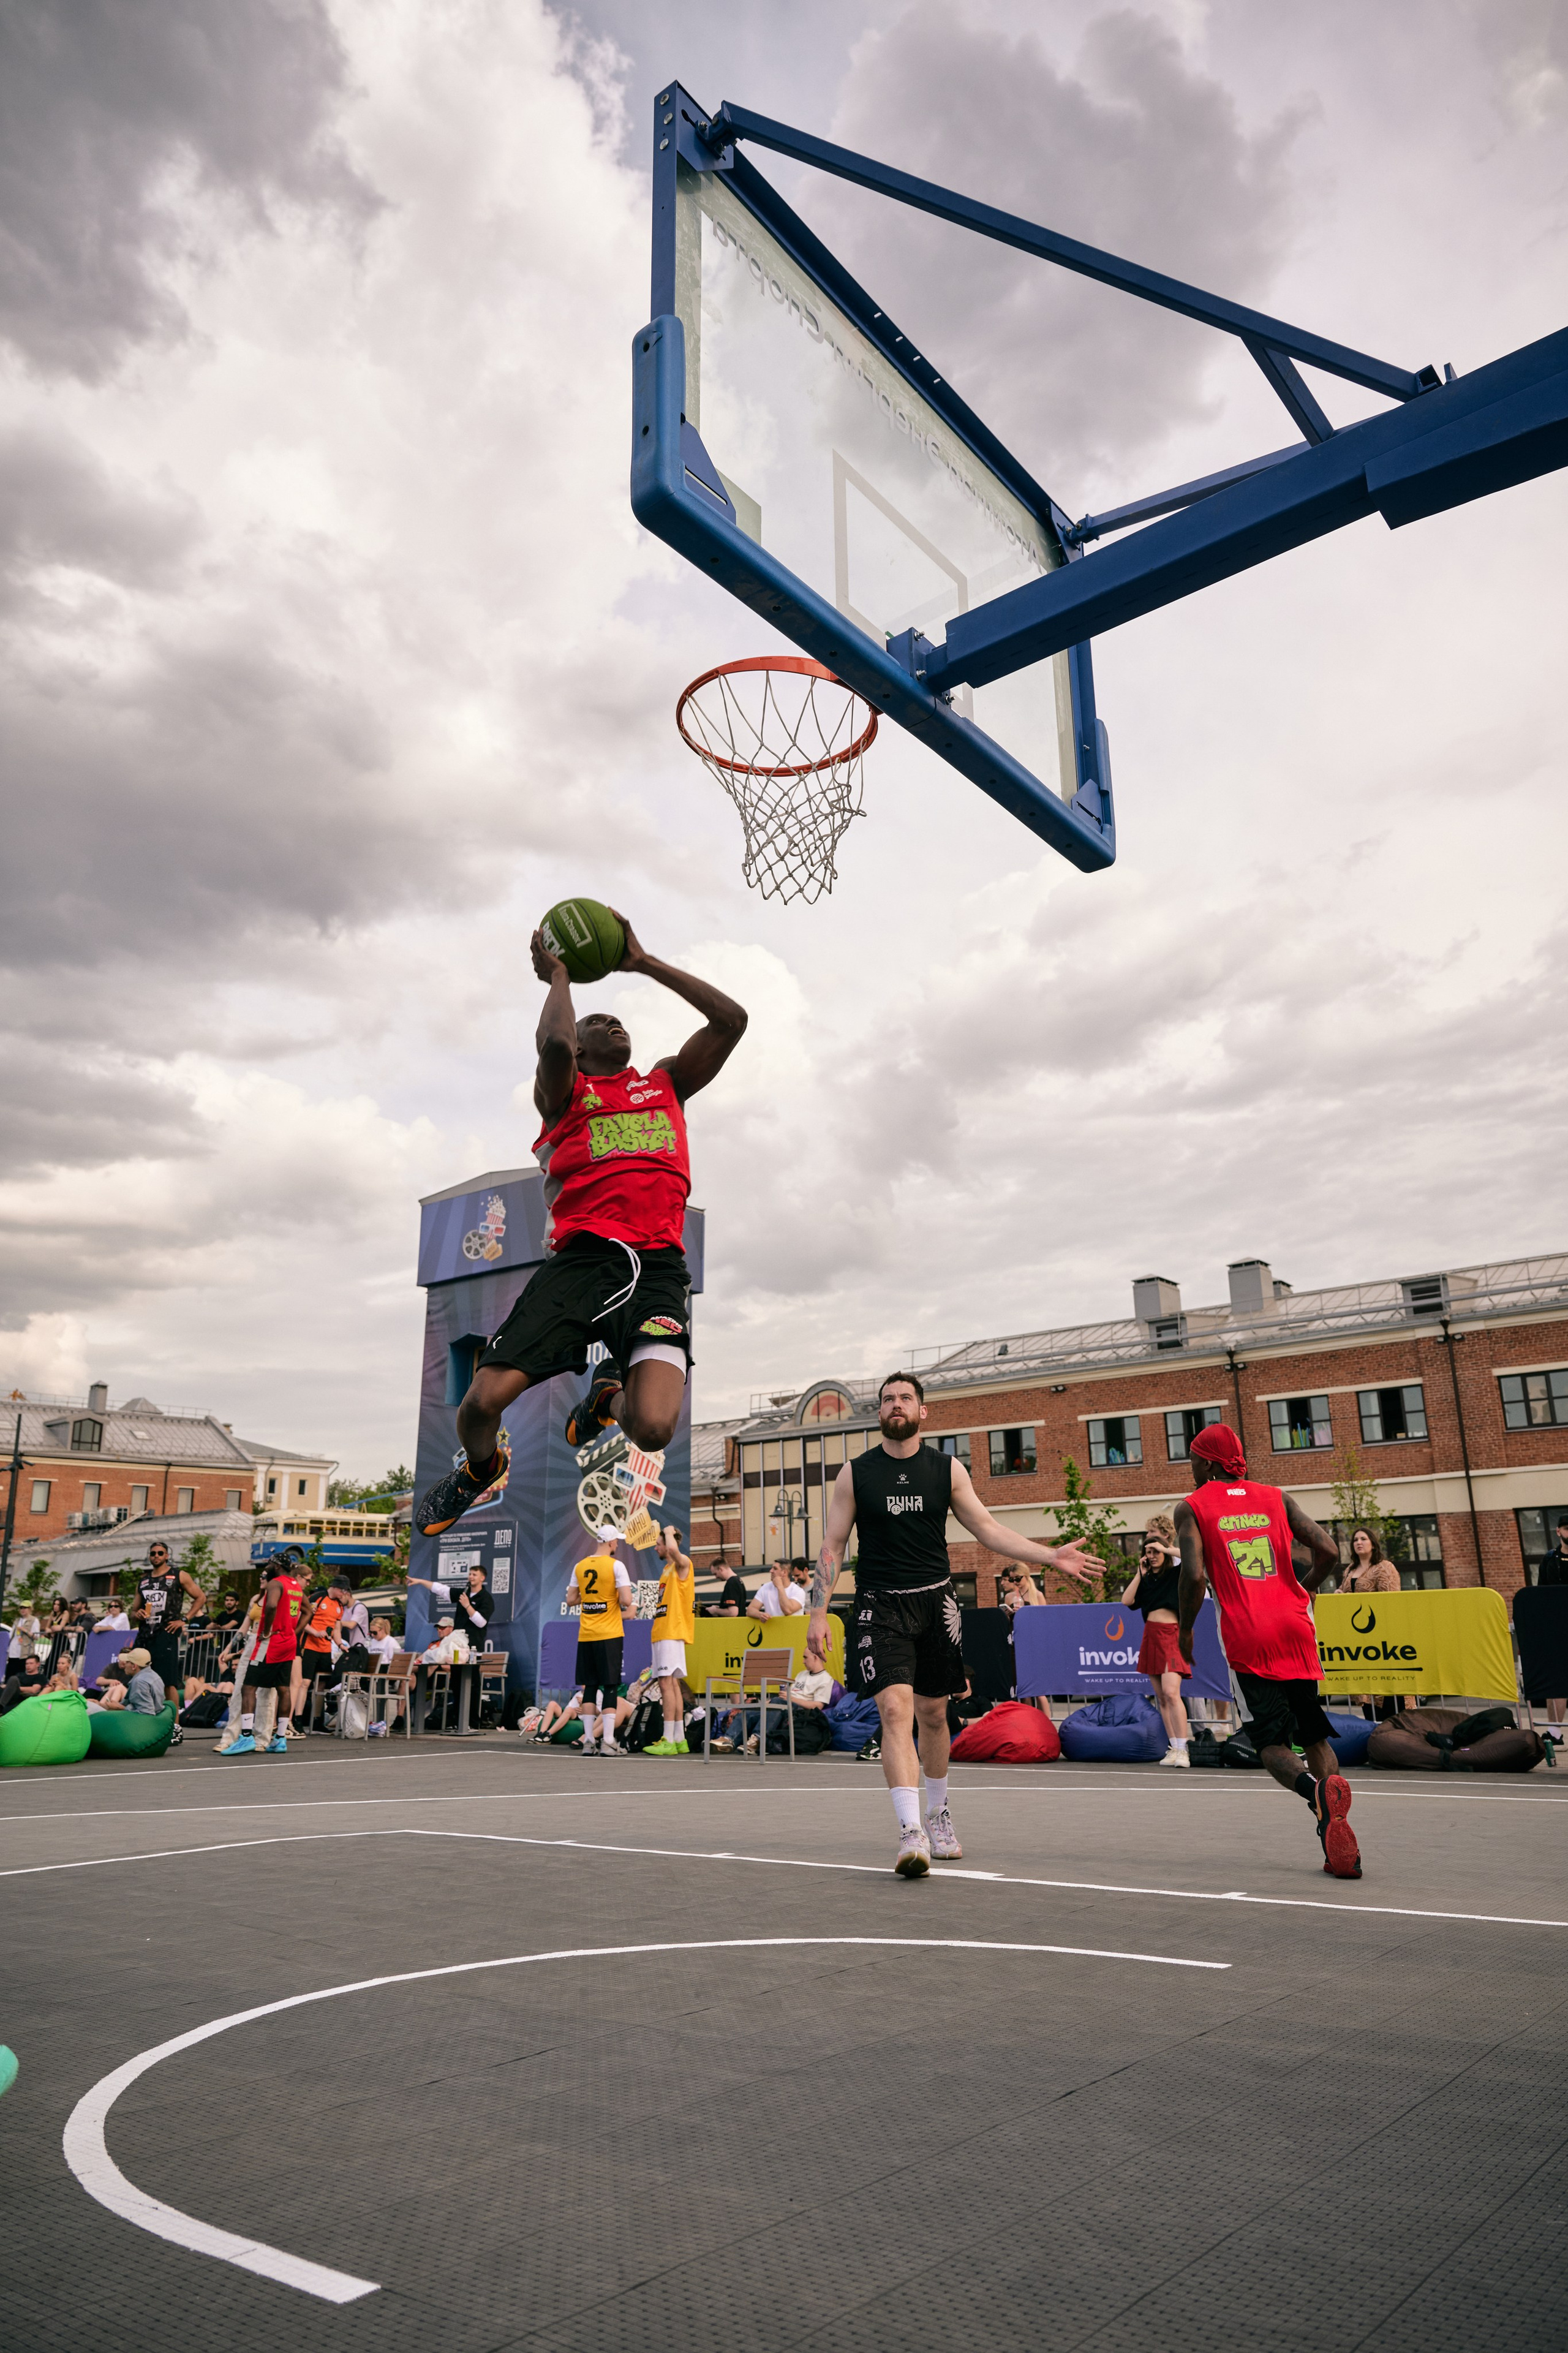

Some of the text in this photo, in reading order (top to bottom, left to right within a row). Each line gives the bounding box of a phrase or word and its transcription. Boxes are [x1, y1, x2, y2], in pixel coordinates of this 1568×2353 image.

[590, 1129, 676, 1159] BASKET
[627, 1513, 647, 1538] КИНО
[494, 1529, 512, 1545] ДЕПО
[584, 1569, 598, 1594] 2
[725, 1652, 744, 1667] in
[1079, 1647, 1140, 1666] invok
[1319, 1641, 1417, 1661] invoke
[859, 1656, 876, 1683] 13
